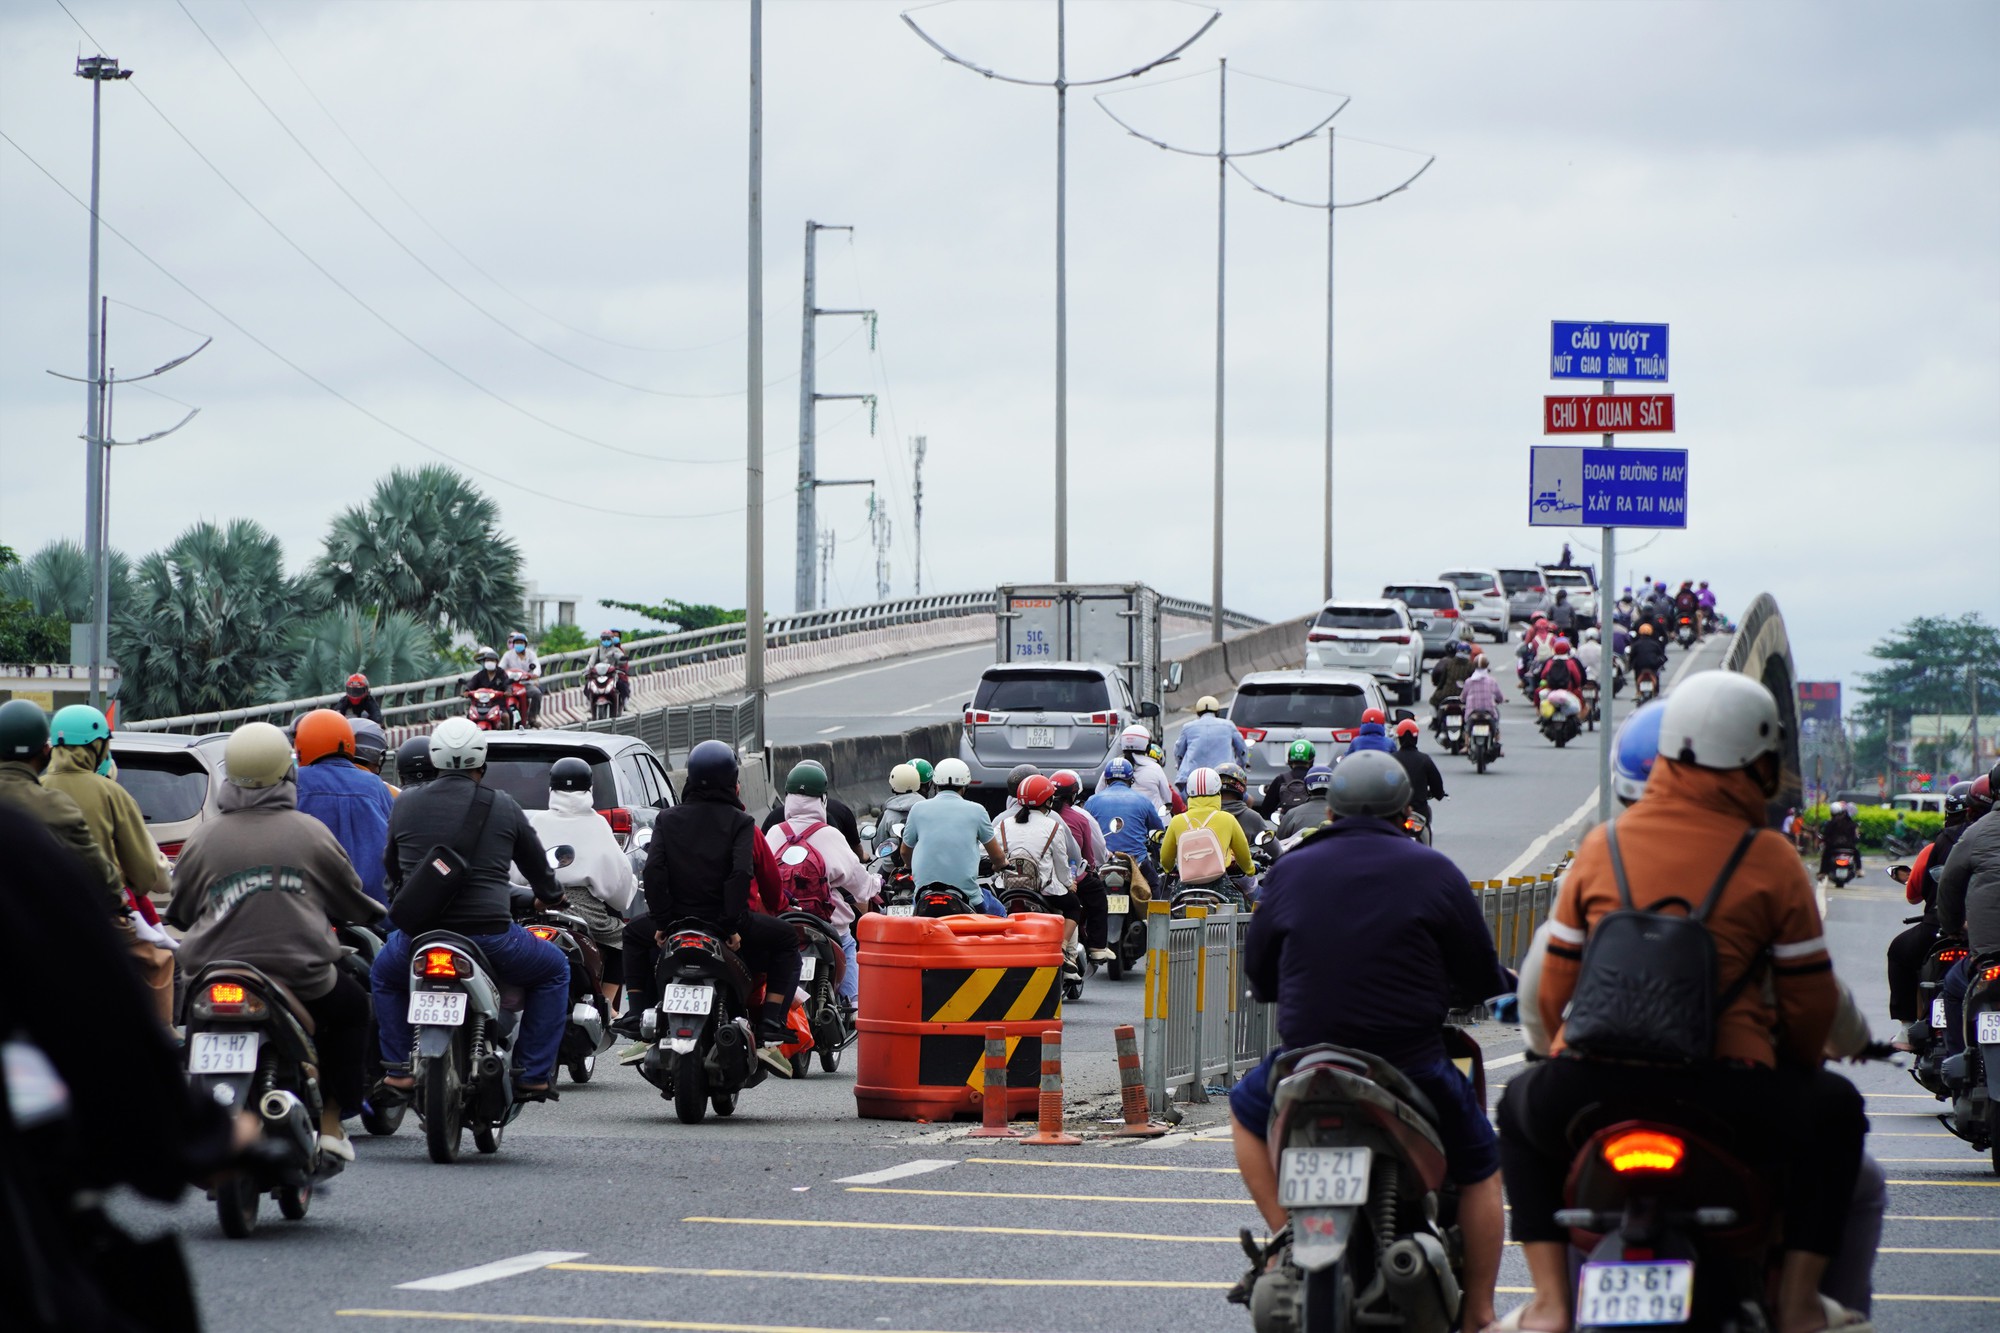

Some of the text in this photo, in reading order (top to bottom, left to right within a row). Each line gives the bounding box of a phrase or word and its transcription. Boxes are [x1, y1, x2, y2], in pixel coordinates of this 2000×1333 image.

[1608, 329, 1650, 354] VƯỢT
[1553, 351, 1665, 379] NÚT GIAO BÌNH THUẬN
[1552, 396, 1664, 428] CHÚ Ý QUAN SÁT
[1584, 460, 1684, 483] ĐOẠN ĐƯỜNG HAY
[1587, 489, 1684, 516] XẢY RA TAI NẠN
[1011, 599, 1052, 608] ISUZU
[1027, 630, 1043, 642] 51C
[1033, 728, 1048, 737] 62A
[419, 995, 458, 1009] 59-X3
[672, 987, 705, 1000] 63-C1
[666, 999, 708, 1013] 274.81
[413, 1008, 460, 1023] 866.99
[202, 1035, 248, 1052] 71-H7
[200, 1053, 245, 1070] 3791
[1295, 1151, 1353, 1175] 59-Z1
[1284, 1176, 1363, 1202] 013.87
